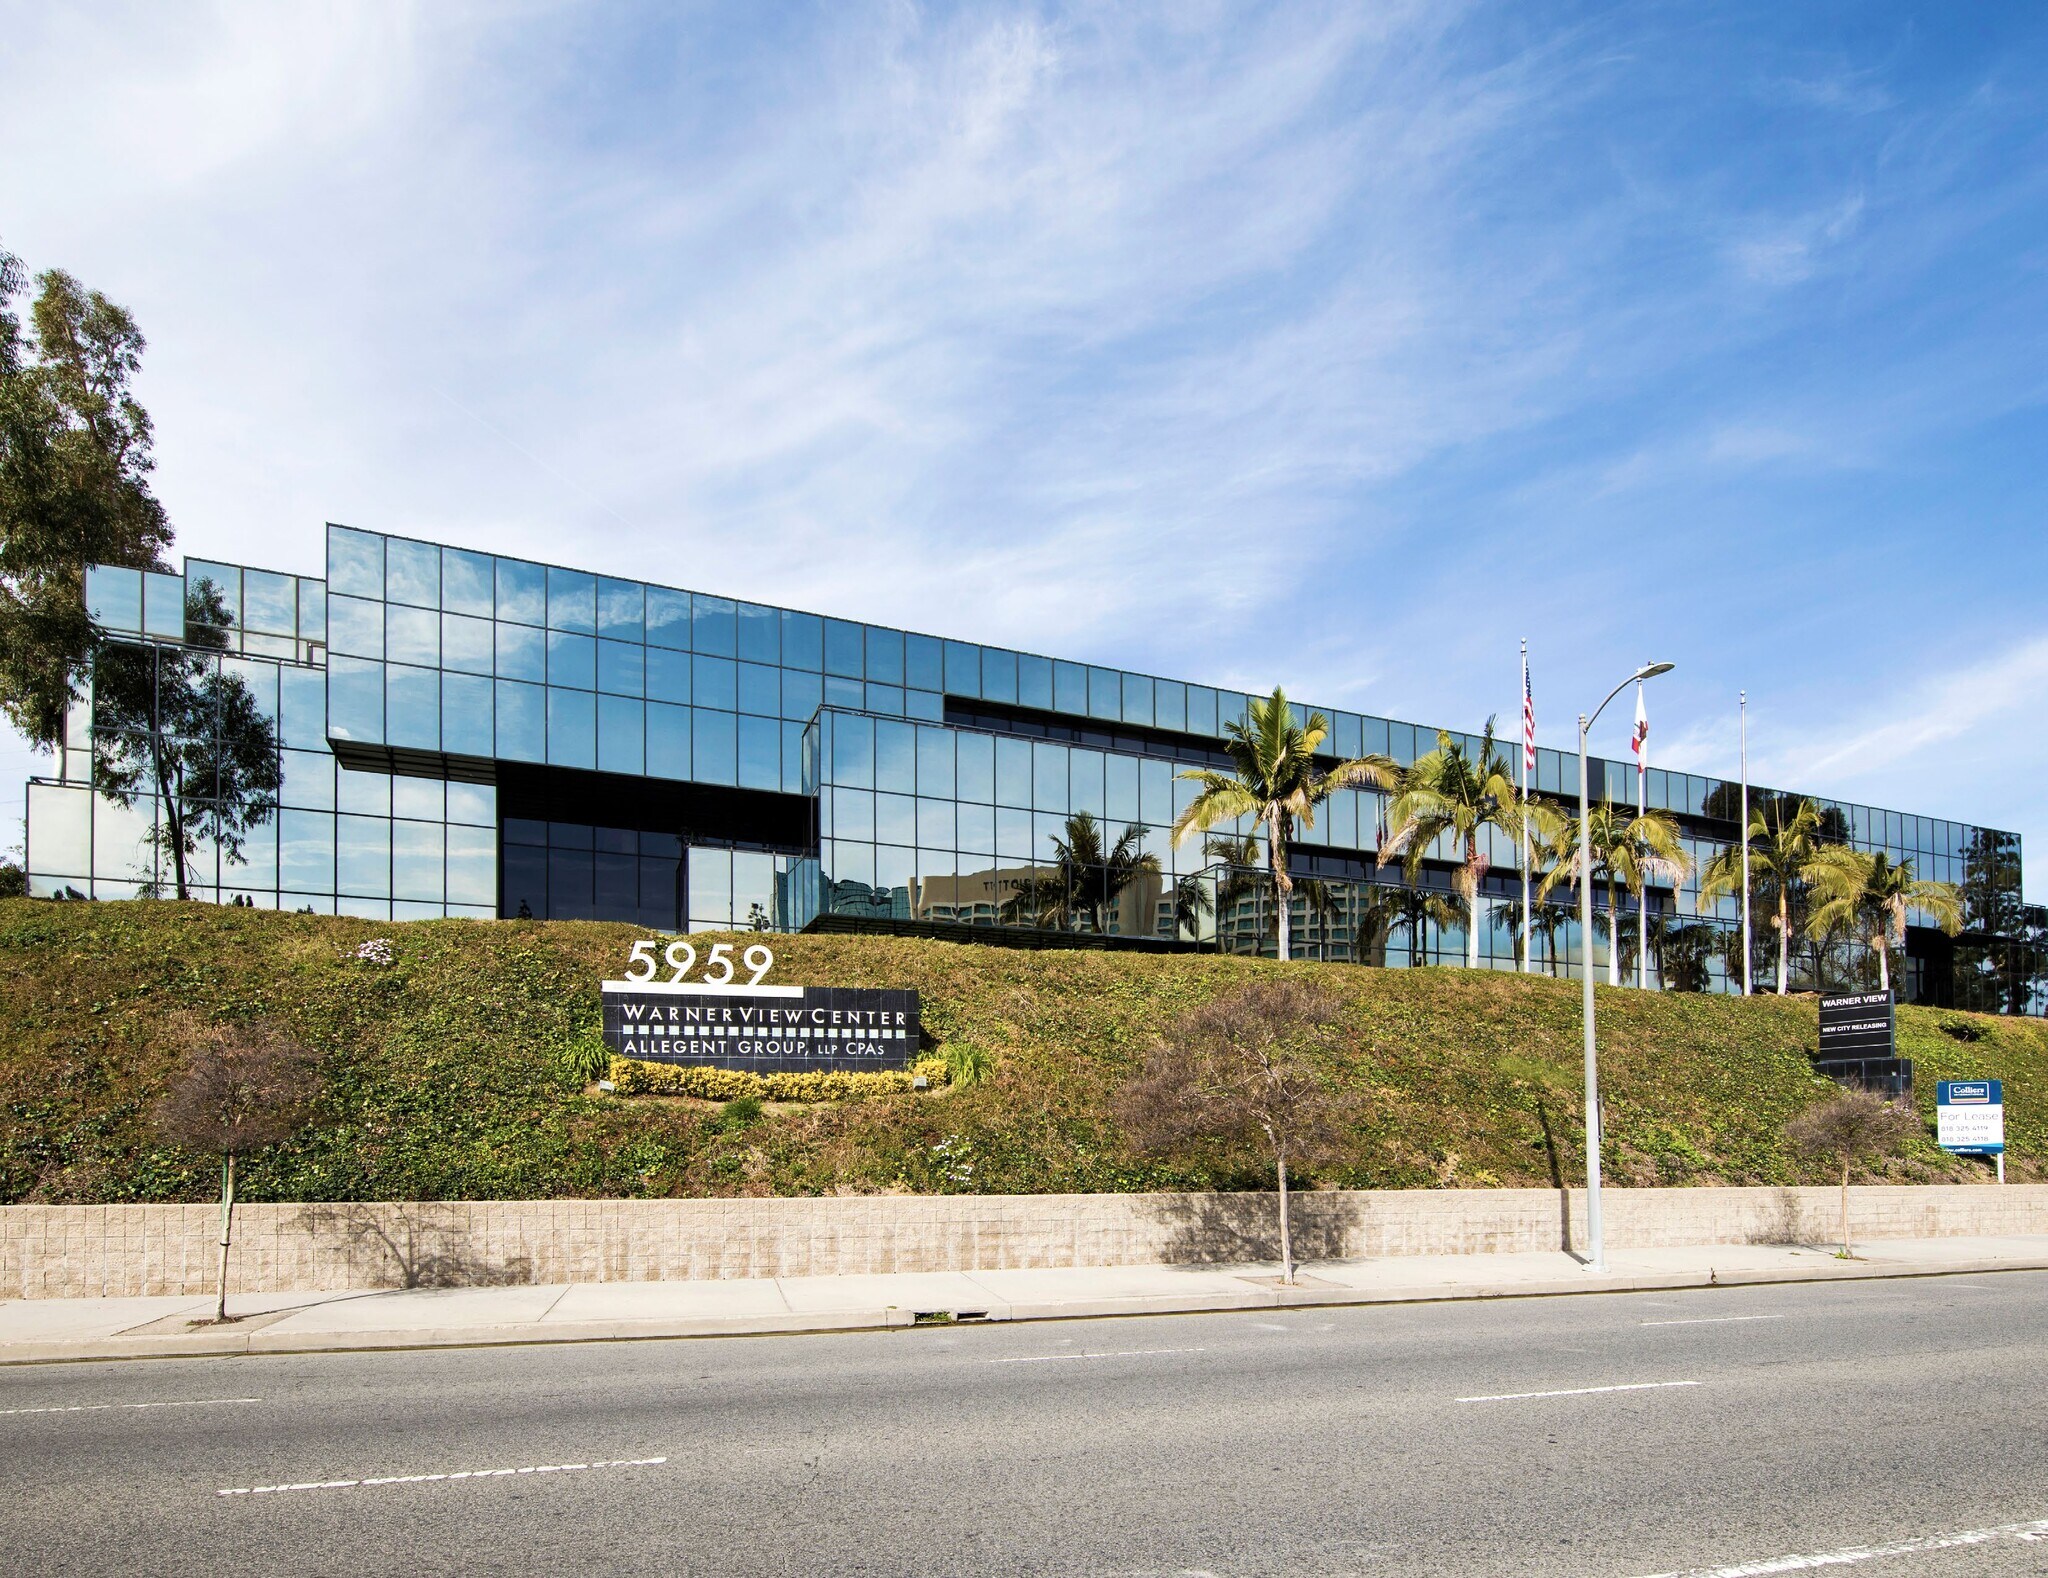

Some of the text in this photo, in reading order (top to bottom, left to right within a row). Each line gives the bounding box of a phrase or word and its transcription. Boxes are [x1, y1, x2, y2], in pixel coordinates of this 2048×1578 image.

[624, 940, 774, 986] 5959
[1822, 994, 1887, 1008] WARNER VIEW
[811, 1008, 906, 1026] CENTER
[1851, 1022, 1887, 1030] RELEASING
[623, 1039, 728, 1055] ALLEGENT
[737, 1040, 809, 1057] GROUP,
[817, 1044, 839, 1055] LLP
[1940, 1112, 1999, 1121] For Lease
